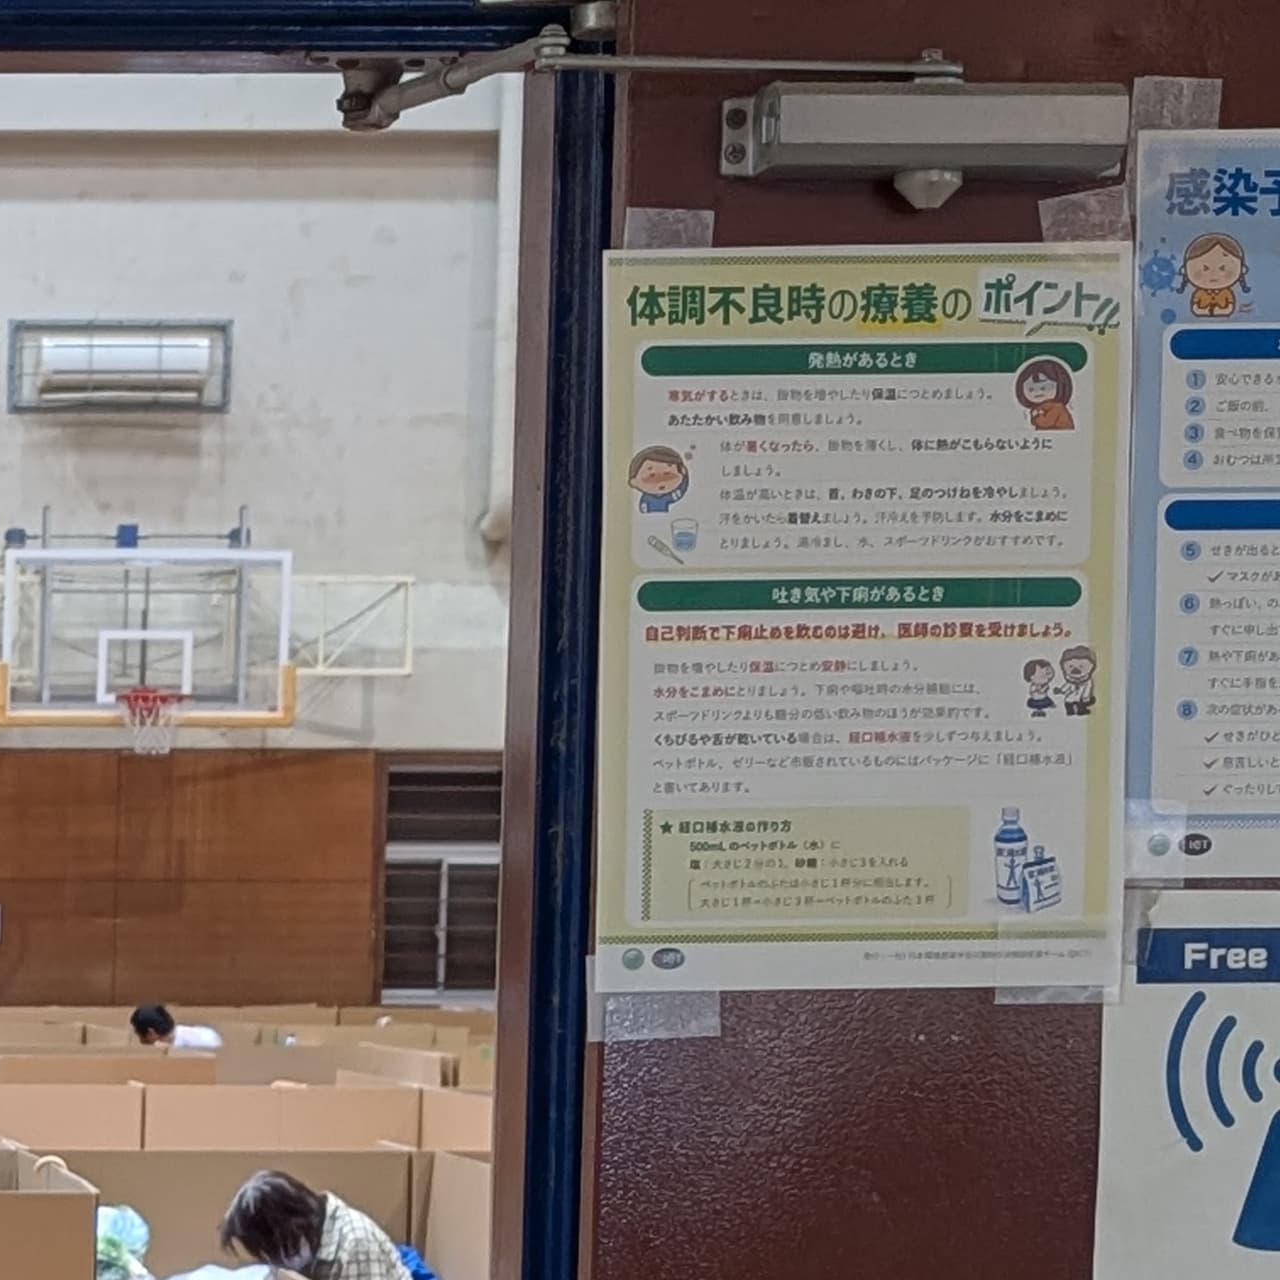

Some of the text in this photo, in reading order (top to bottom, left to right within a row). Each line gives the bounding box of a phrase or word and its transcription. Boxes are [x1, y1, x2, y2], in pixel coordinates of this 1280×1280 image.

[808, 350, 918, 370] 発熱があるとき
[1215, 373, 1280, 386] 安心できる
[1215, 427, 1280, 440] 食べ物を保
[772, 585, 946, 605] 吐き気や下痢があるとき
[1210, 623, 1280, 636] すぐに申し出
[1183, 942, 1268, 970] Free
